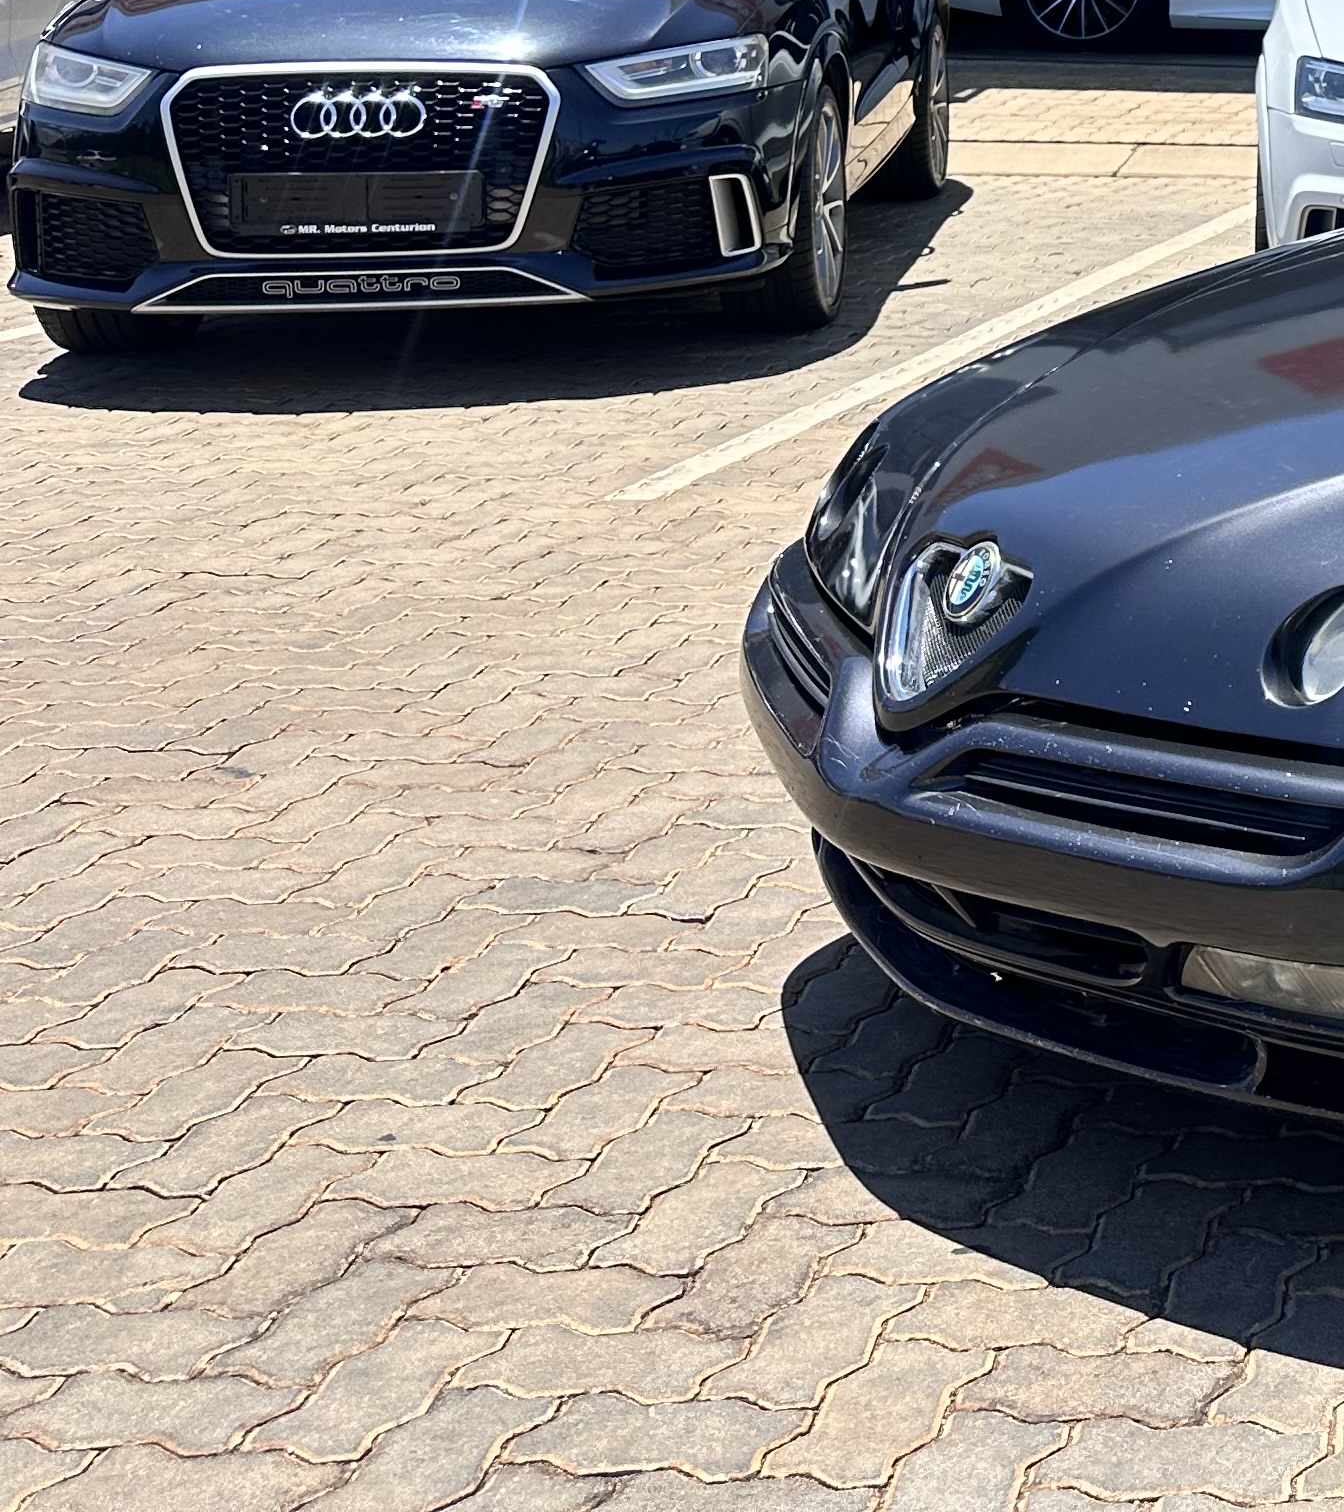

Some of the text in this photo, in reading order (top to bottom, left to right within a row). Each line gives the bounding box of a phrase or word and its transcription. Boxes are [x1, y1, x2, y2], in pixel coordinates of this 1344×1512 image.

[298, 223, 436, 234] MR. Motors Centurion
[262, 275, 461, 298] quattro
